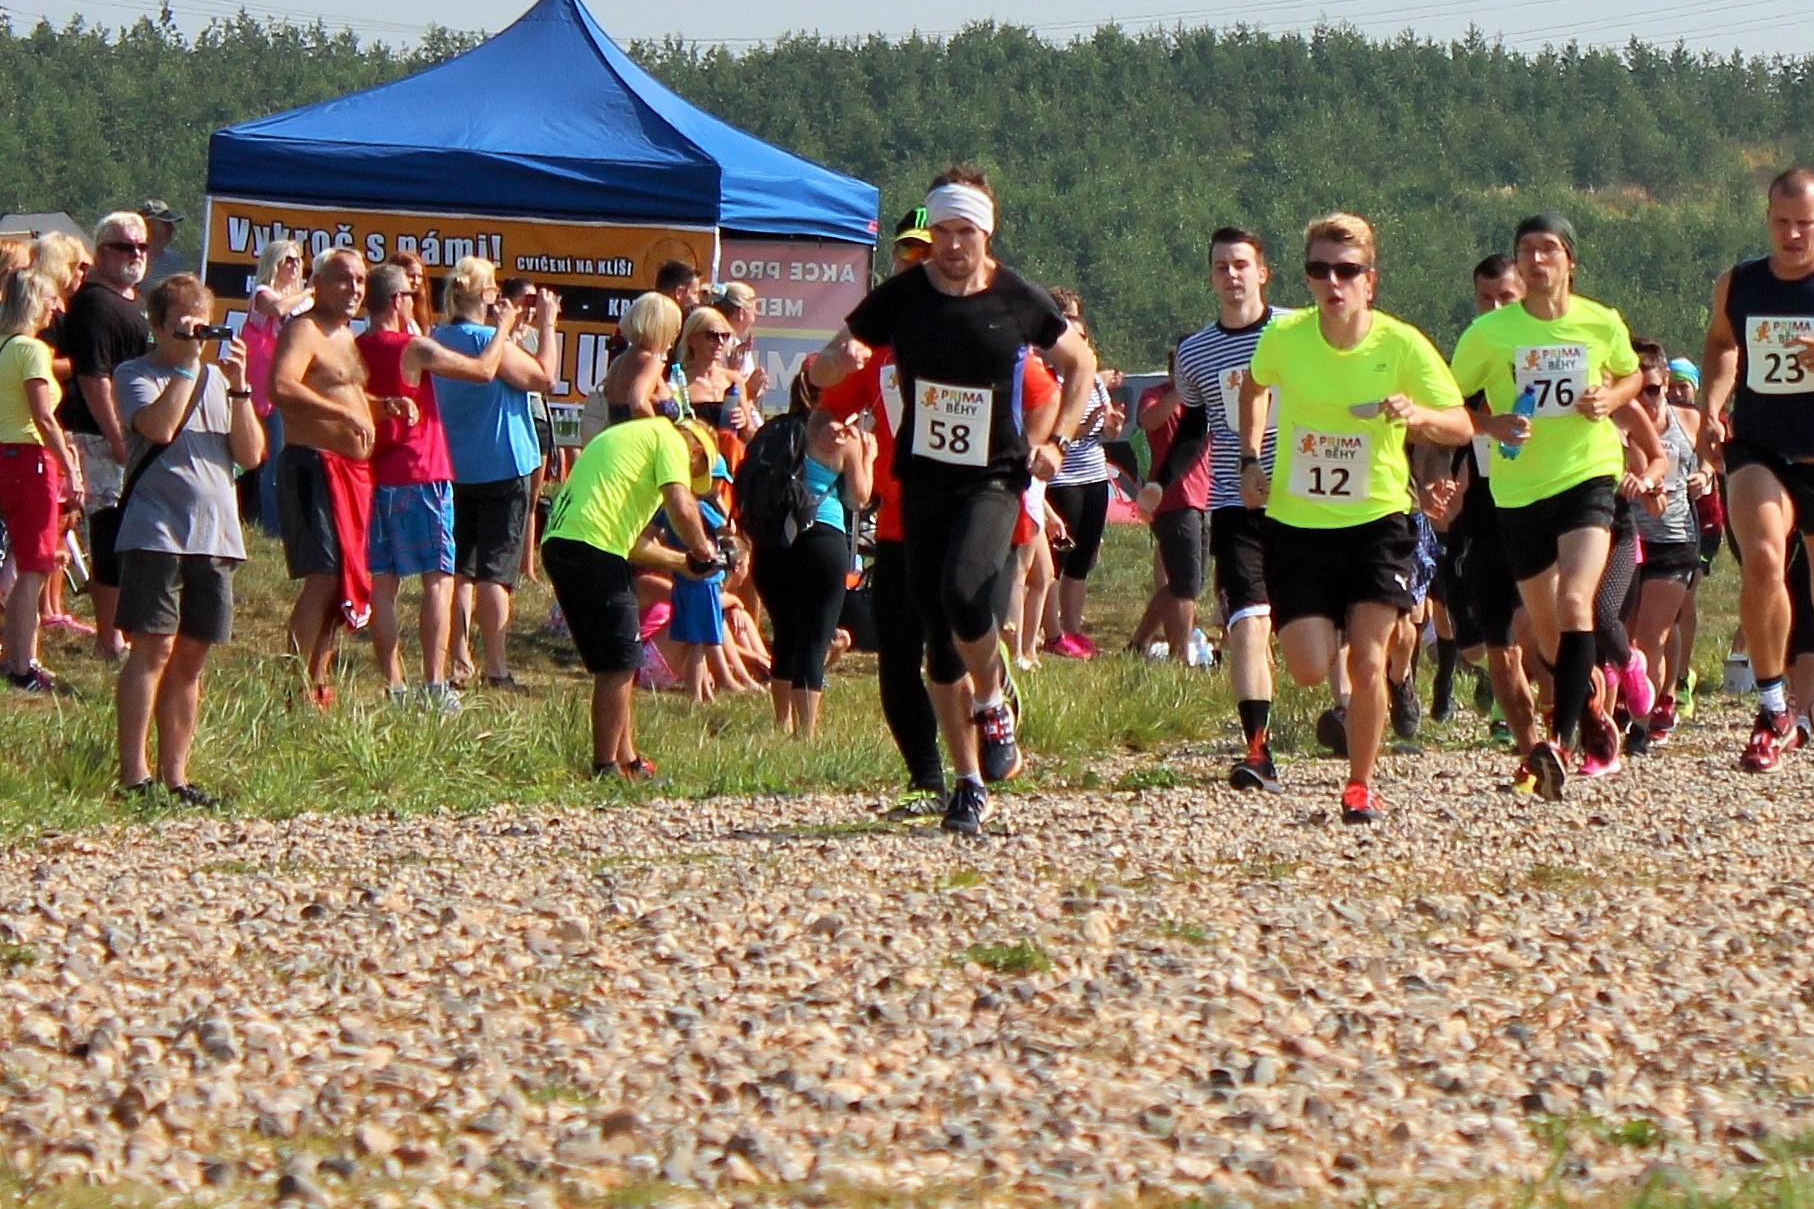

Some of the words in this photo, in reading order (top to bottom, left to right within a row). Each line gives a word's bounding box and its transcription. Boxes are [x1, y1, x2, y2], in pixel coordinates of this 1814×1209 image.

[366, 233, 386, 263] s
[516, 255, 572, 273] CVIČENÍ
[576, 259, 594, 274] NA
[1542, 347, 1581, 359] PRIMA
[1547, 358, 1576, 370] BĚHY
[1763, 352, 1804, 384] 23
[941, 389, 984, 404] PRIMA
[1533, 378, 1574, 408] 76
[945, 400, 978, 415] BĚHY
[928, 419, 971, 454] 58
[1319, 436, 1362, 448] PRIMA
[1324, 446, 1357, 459] BĚHY
[1308, 466, 1351, 496] 12
